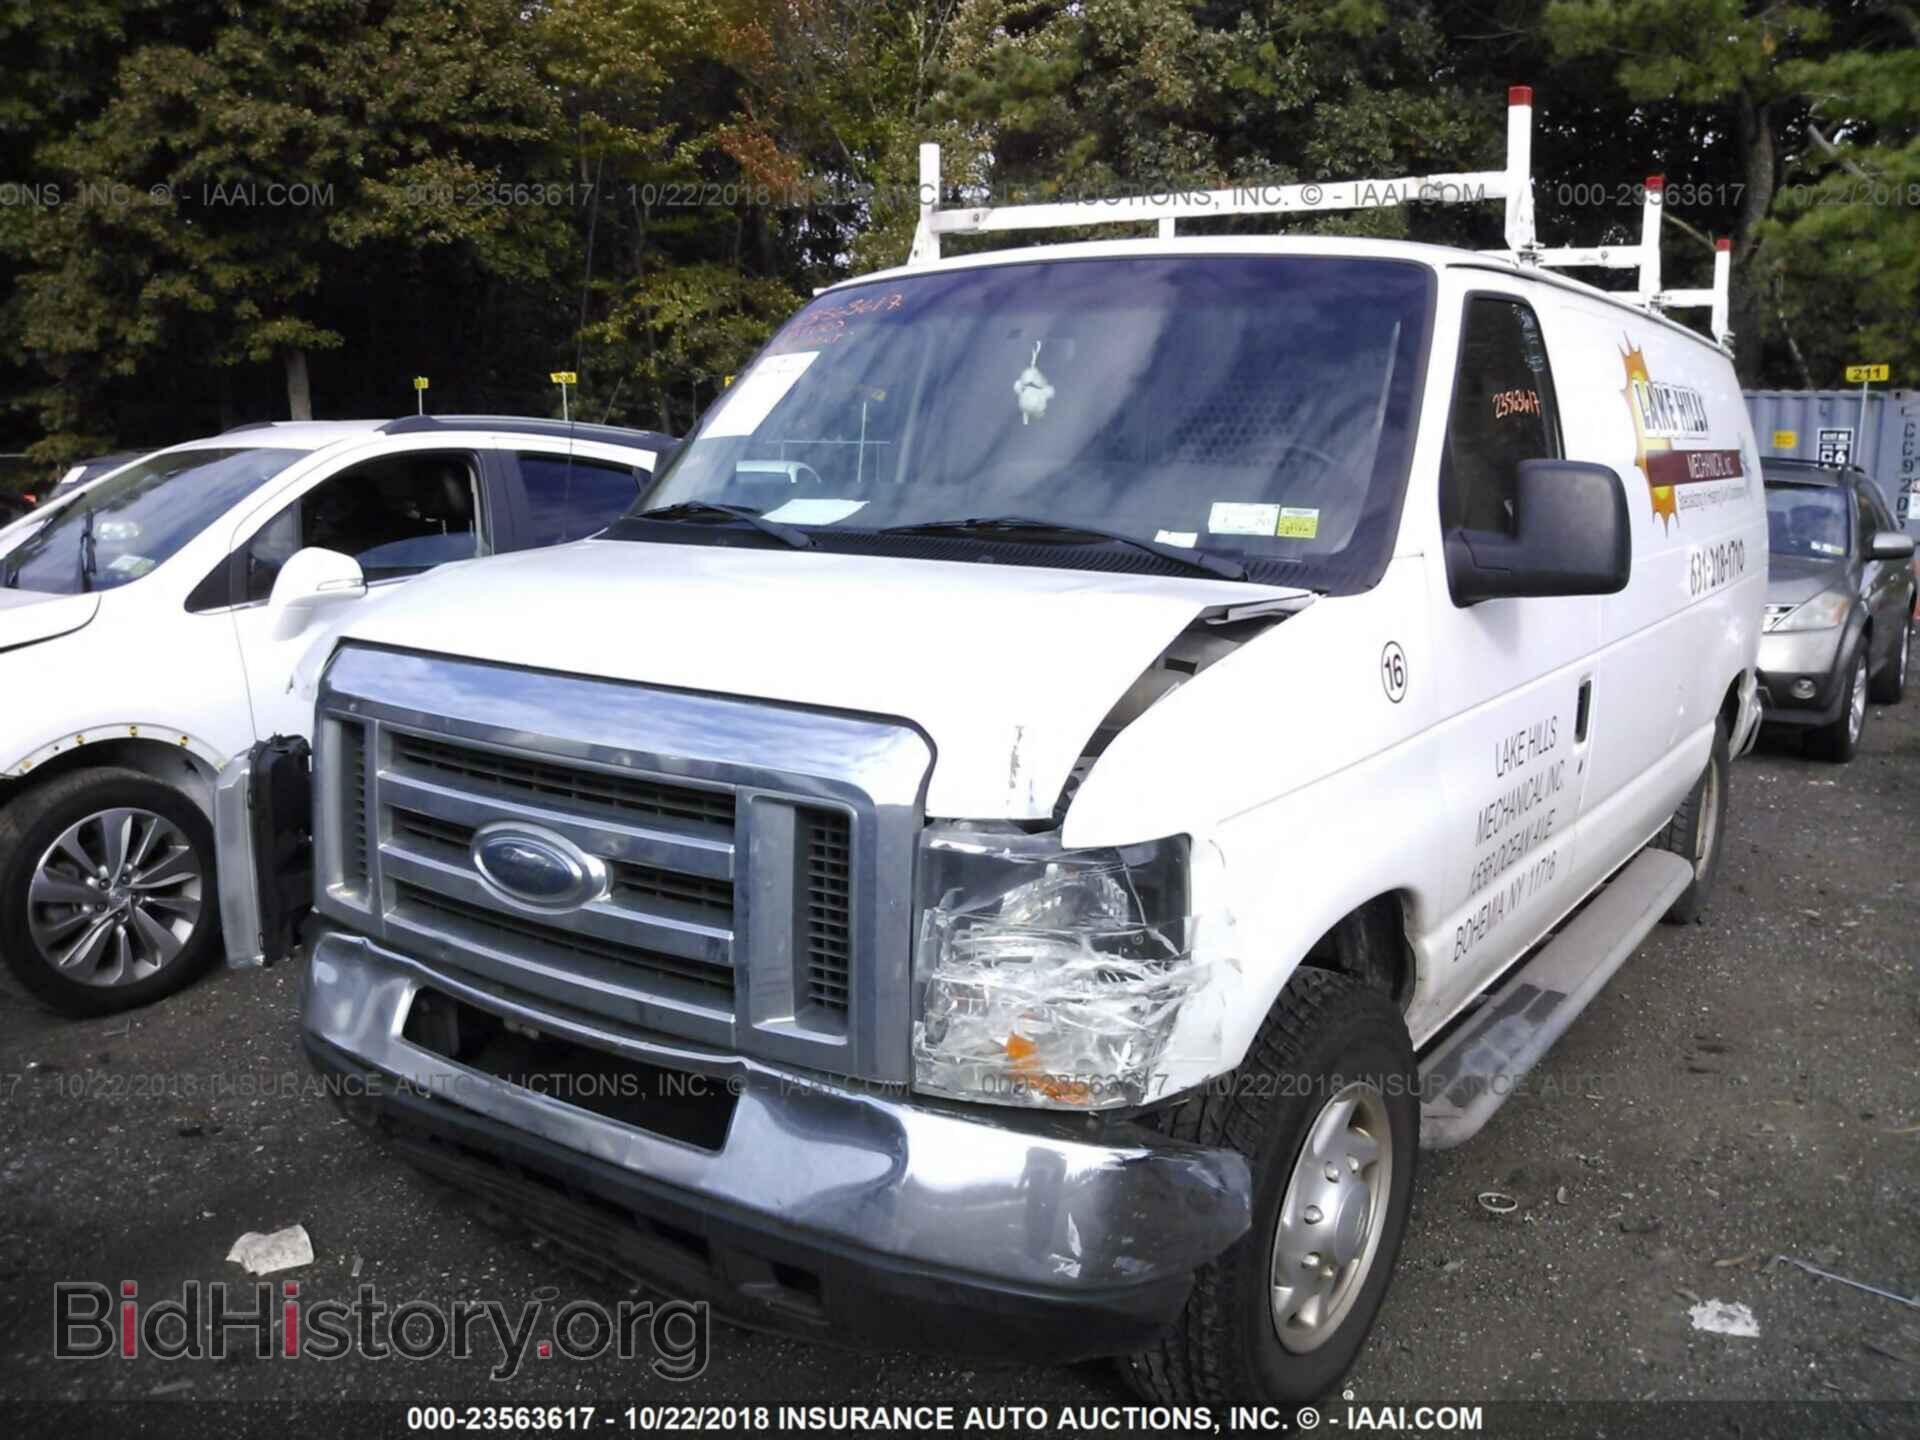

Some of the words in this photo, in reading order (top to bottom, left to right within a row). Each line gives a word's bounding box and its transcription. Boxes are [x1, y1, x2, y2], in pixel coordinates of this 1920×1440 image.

[1853, 367, 1881, 380] 211
[1634, 383, 1678, 431] LAKE
[1673, 389, 1709, 432] HILLS
[1384, 653, 1404, 691] 16
[1494, 729, 1526, 778] LAKE
[1526, 714, 1559, 761] HILLS
[1475, 772, 1545, 847] MECHANICAL
